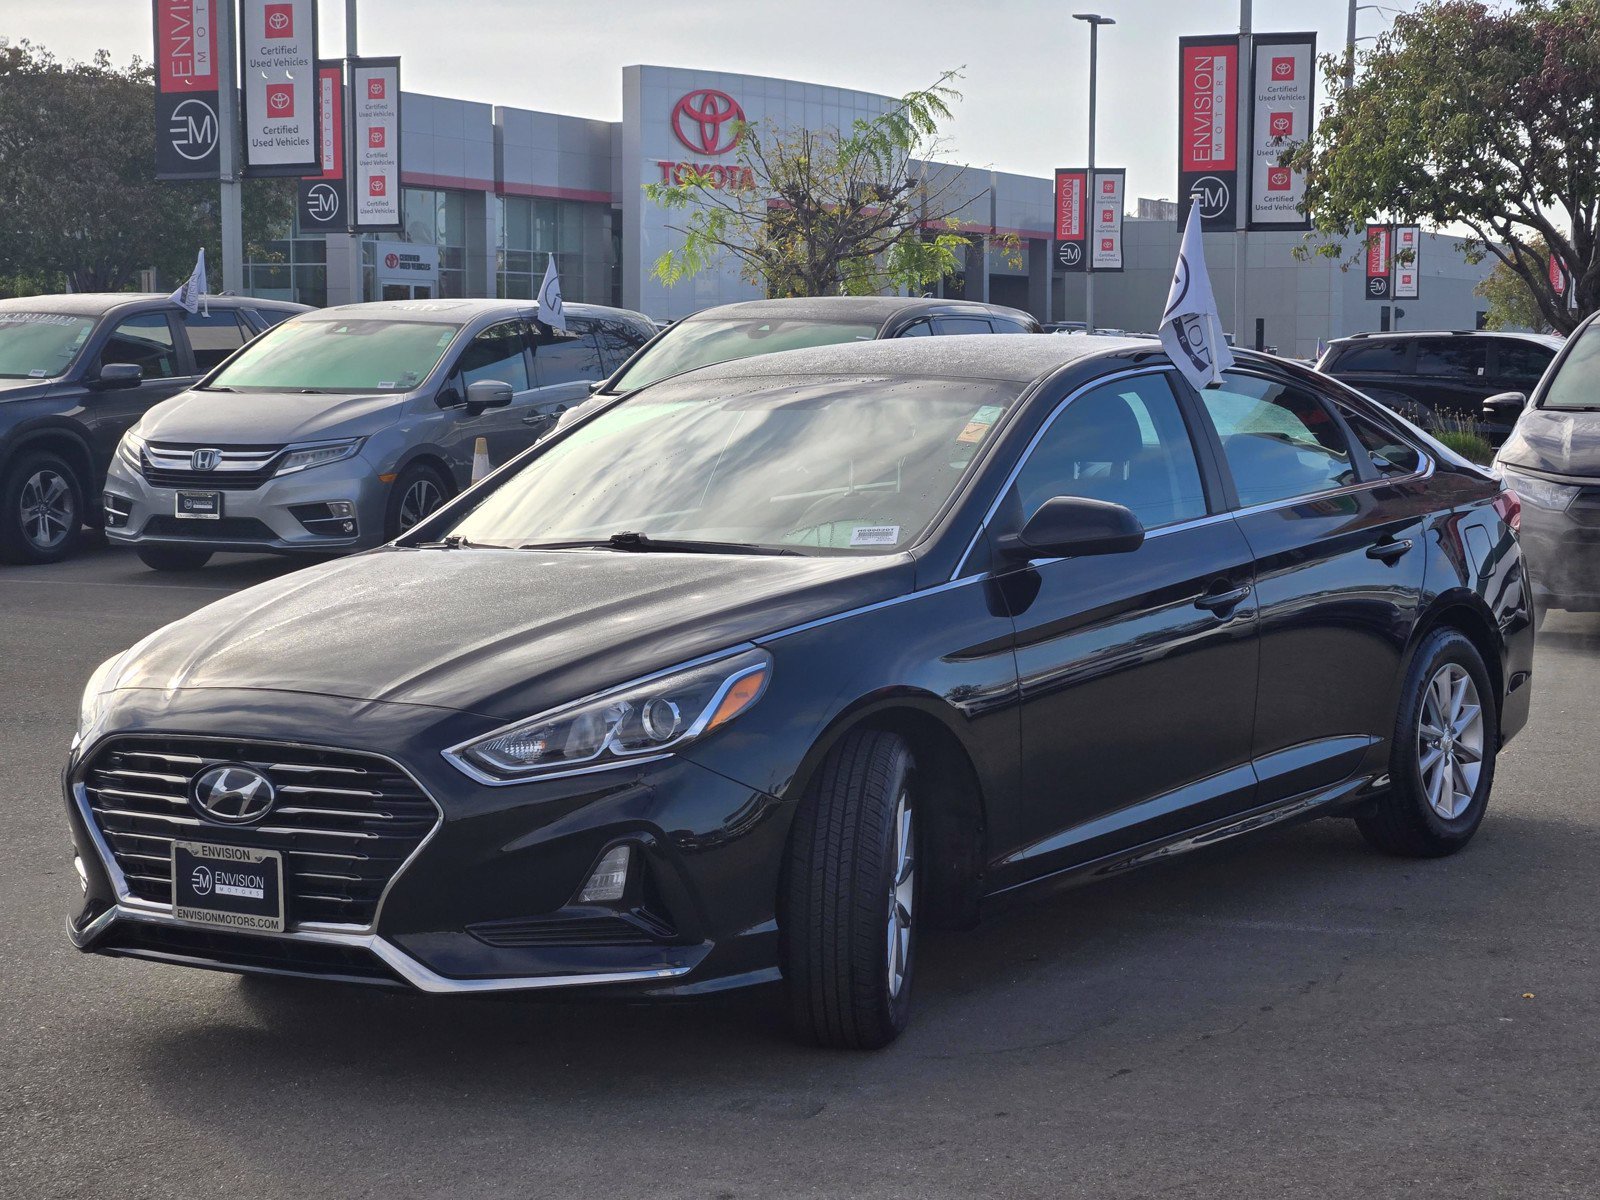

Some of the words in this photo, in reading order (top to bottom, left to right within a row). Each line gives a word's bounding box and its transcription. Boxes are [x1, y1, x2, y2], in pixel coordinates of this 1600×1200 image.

[170, 0, 192, 77] ENVI
[260, 45, 297, 56] Certified
[250, 59, 271, 68] Used
[273, 57, 308, 67] Vehicles
[1267, 85, 1298, 93] Certified
[1193, 56, 1212, 161] ENVISION
[1215, 65, 1224, 151] MOTORS
[262, 124, 299, 135] Certified
[324, 86, 332, 162] MOTORS
[252, 138, 273, 147] Used
[275, 137, 310, 147] Vehicles
[657, 161, 757, 191] TOYOTA
[1061, 178, 1073, 235] ENVISION
[1264, 195, 1294, 203] Certified
[1274, 203, 1297, 211] Vehicl
[201, 845, 251, 860] ENVISION
[214, 871, 264, 889] ENVISION
[219, 886, 260, 897] MOTORS
[177, 908, 279, 930] ENVISIONMOTORS.COM
